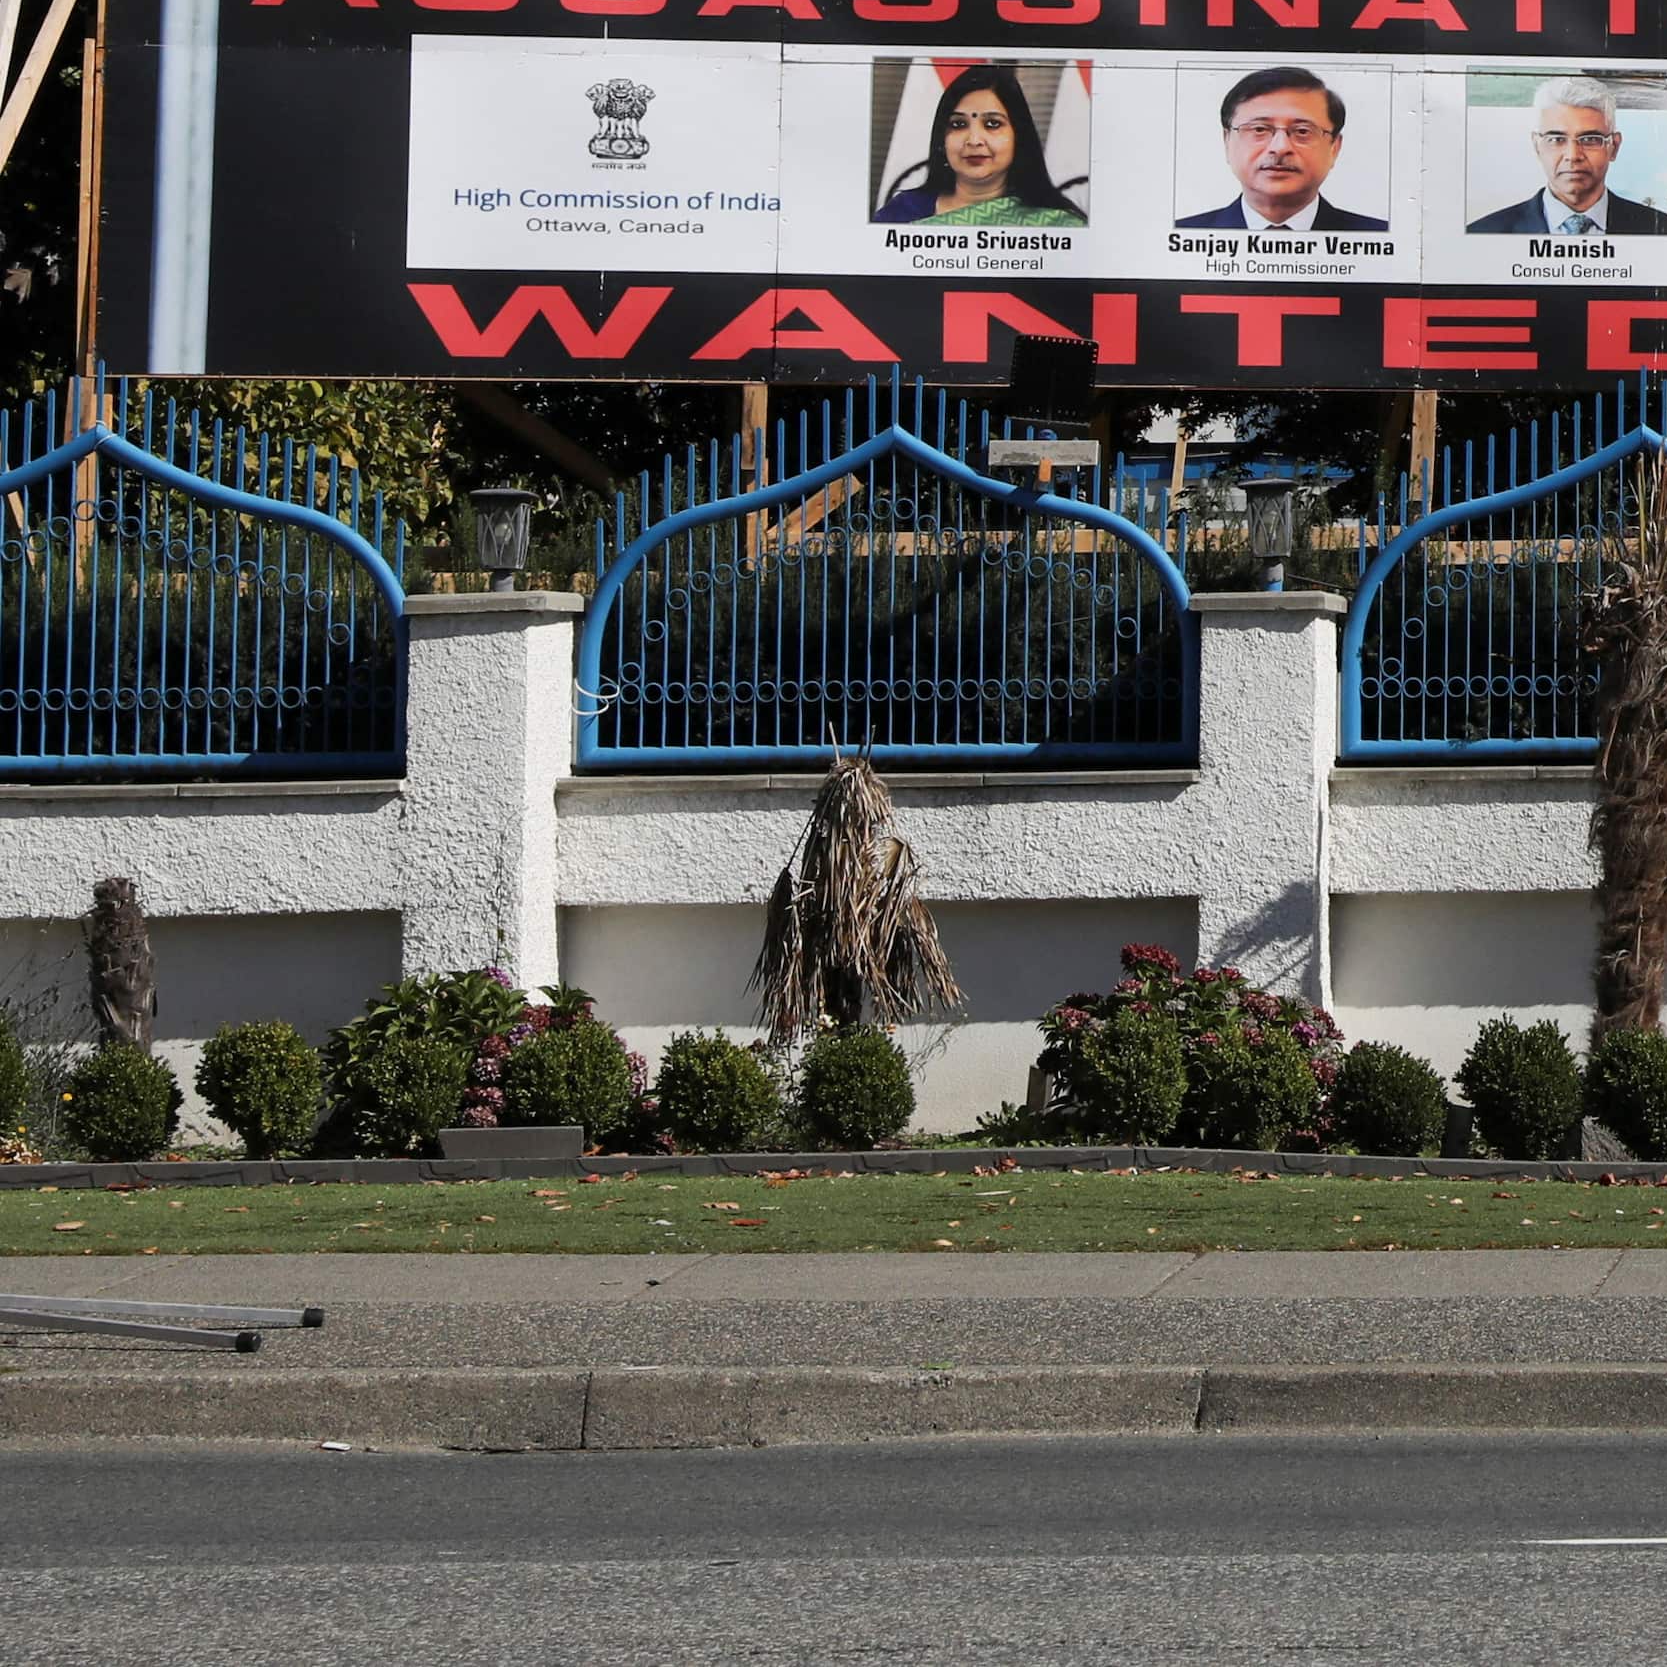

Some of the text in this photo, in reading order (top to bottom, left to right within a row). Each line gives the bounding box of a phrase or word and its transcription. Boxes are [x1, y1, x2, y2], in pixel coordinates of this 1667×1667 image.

[454, 188, 781, 212] High Commission of India
[526, 217, 705, 235] Ottawa, Canada
[885, 229, 1073, 253] Apoorva Srivastva
[1168, 234, 1395, 258] Sanjay Kumar Verma
[1529, 239, 1616, 259] Manish
[912, 255, 1044, 271] Consul General
[1205, 259, 1356, 276] High Commissioner
[1511, 264, 1633, 279] Consul General
